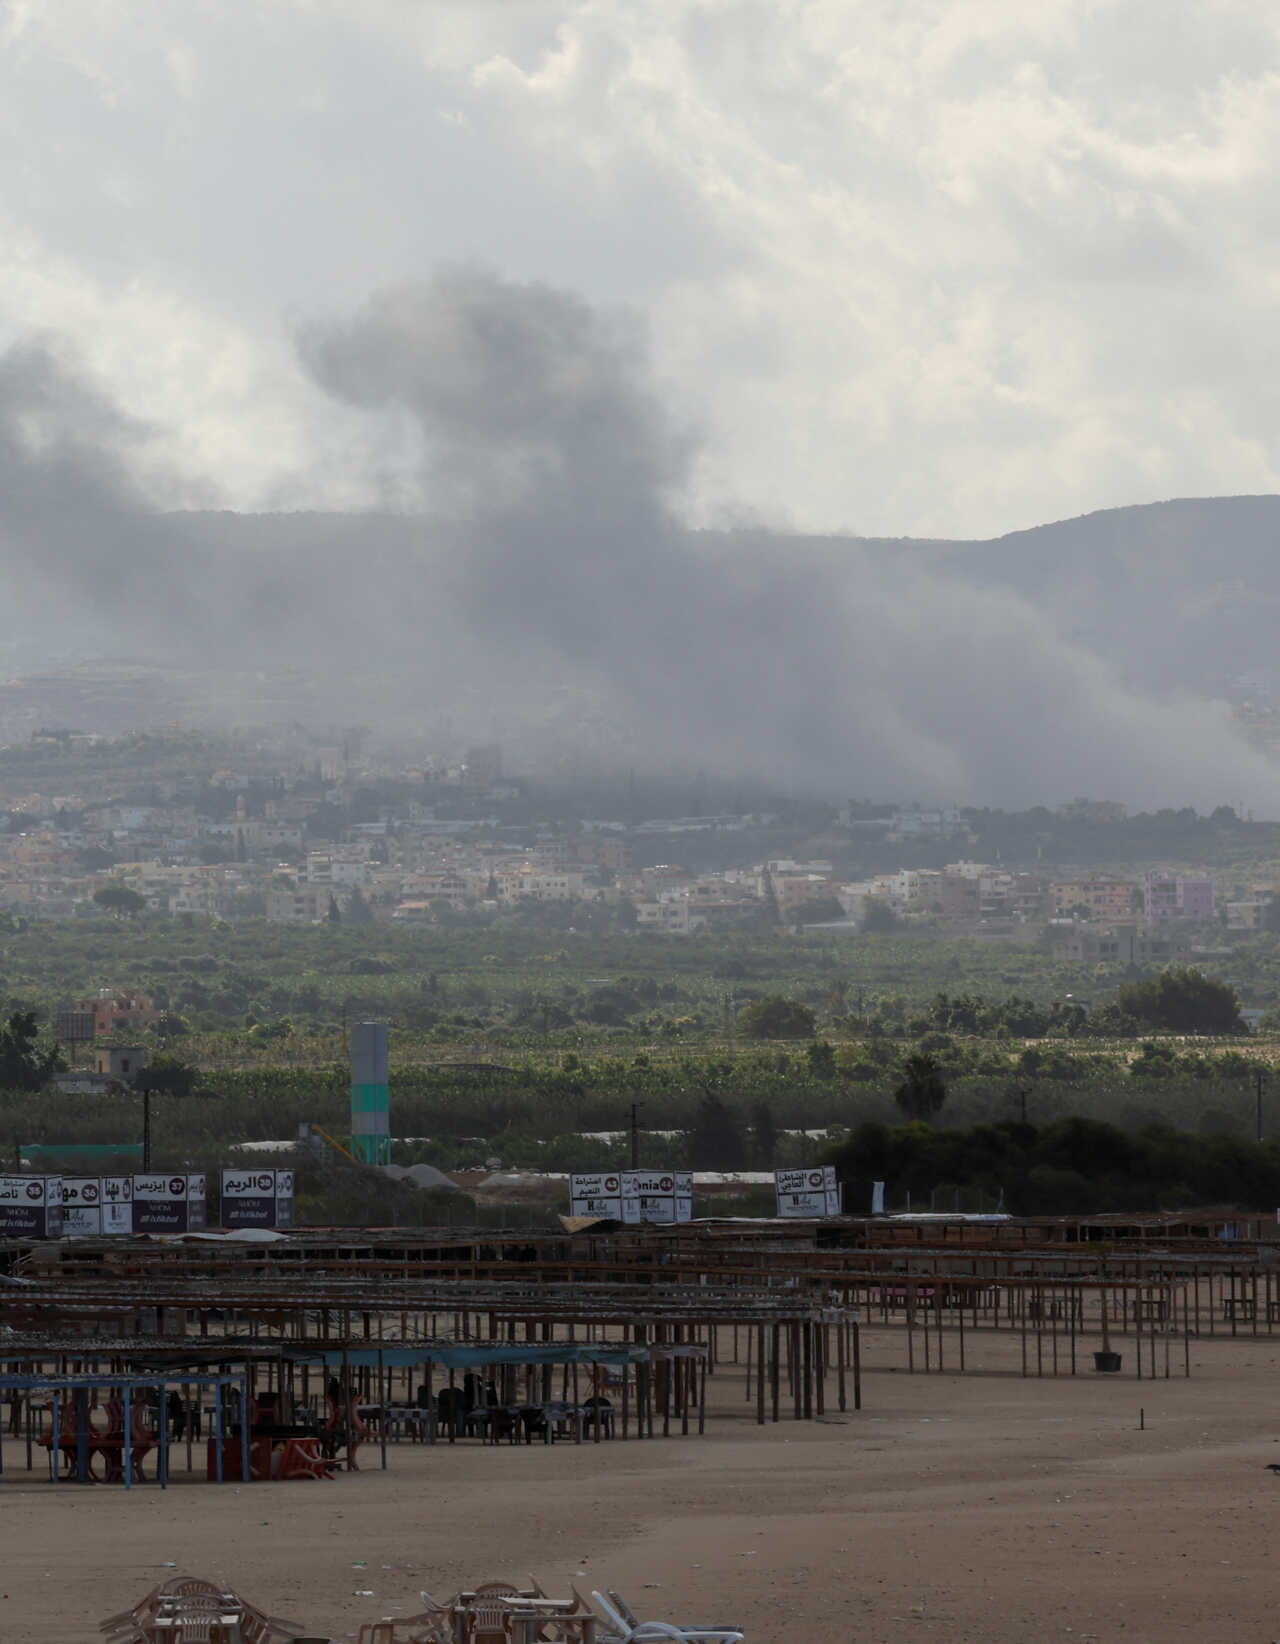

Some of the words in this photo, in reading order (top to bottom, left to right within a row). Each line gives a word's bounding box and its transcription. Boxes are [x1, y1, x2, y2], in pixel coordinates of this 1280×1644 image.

[171, 1182, 183, 1191] 37
[225, 1176, 257, 1193] الريم
[84, 1188, 97, 1198] 36
